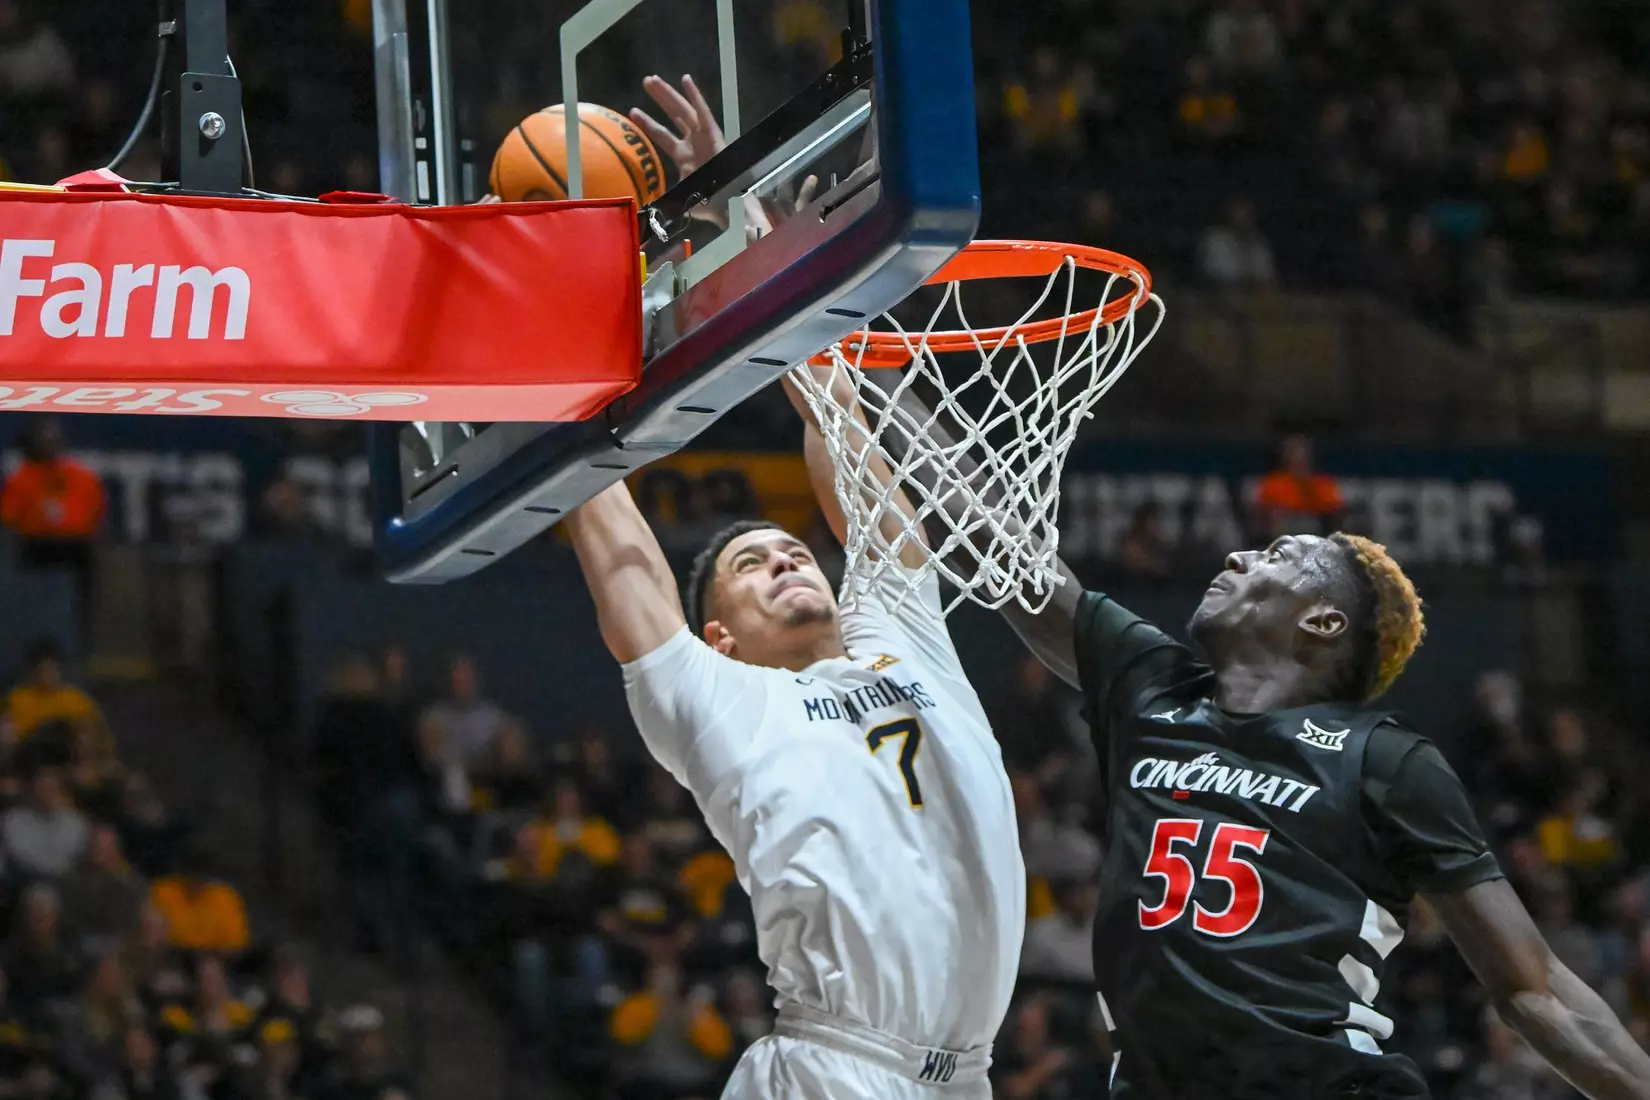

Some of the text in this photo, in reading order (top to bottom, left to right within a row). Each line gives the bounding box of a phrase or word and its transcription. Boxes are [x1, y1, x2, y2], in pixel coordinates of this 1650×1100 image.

[0, 239, 251, 340] Farm
[865, 717, 924, 809] 7
[1129, 757, 1321, 813] CINCINNATI
[1137, 818, 1271, 938] 55
[919, 1049, 958, 1082] WVU
